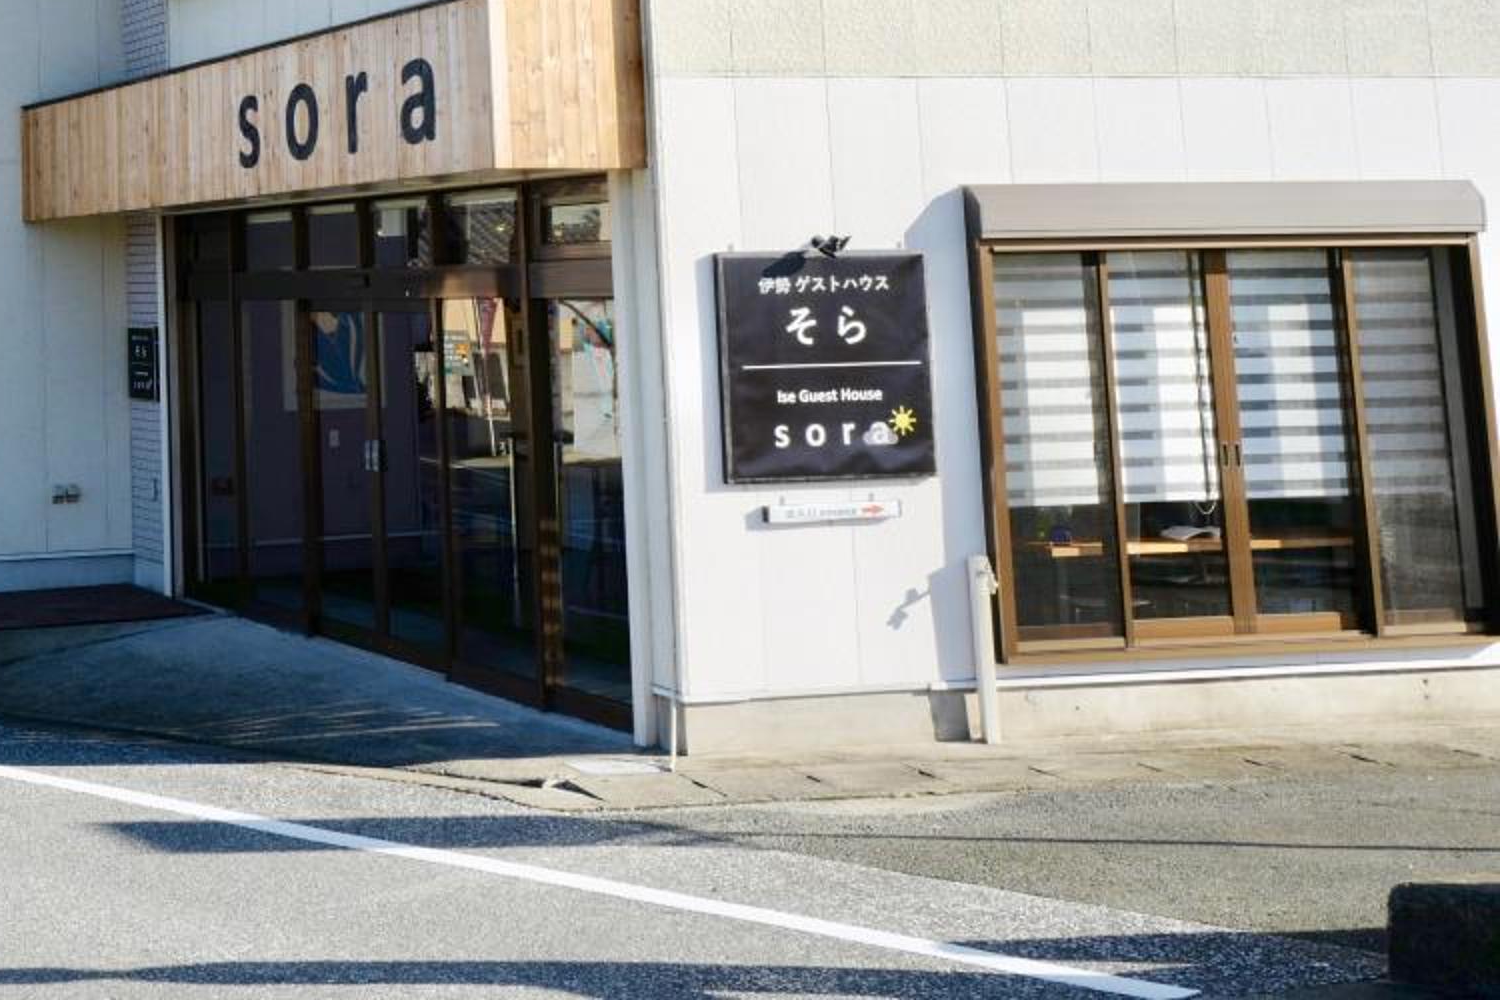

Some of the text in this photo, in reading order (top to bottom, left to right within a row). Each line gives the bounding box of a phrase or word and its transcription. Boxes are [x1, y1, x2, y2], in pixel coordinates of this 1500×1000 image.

[238, 57, 437, 169] sora
[758, 274, 889, 295] 伊勢 ゲストハウス
[786, 306, 866, 344] そら
[777, 387, 883, 403] Ise Guest House
[774, 422, 890, 448] sora
